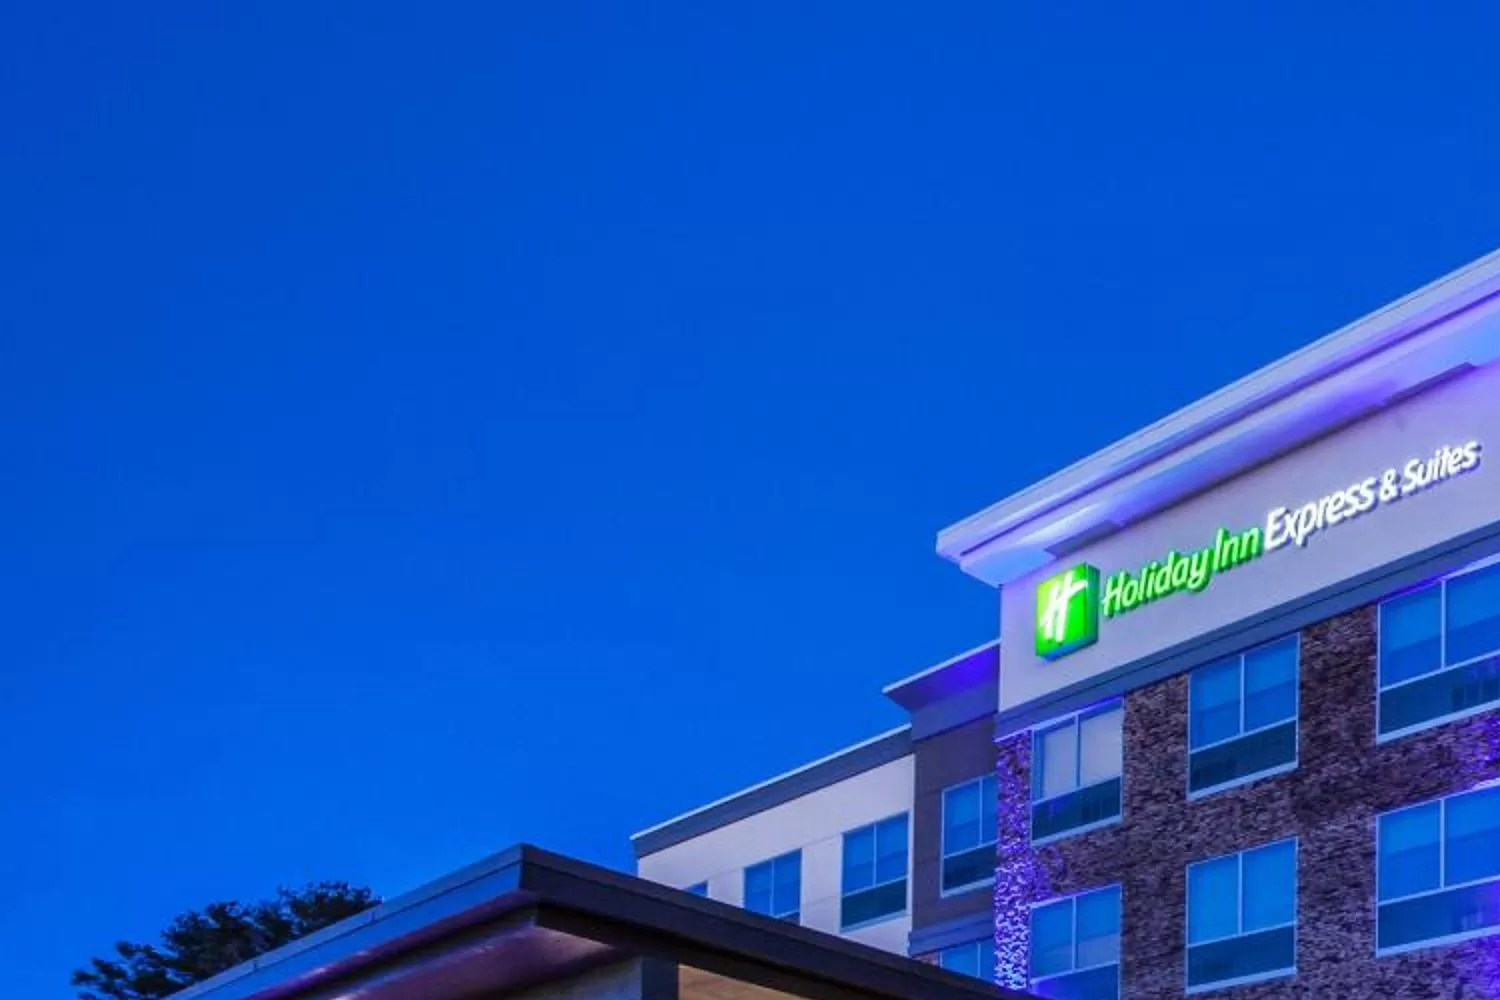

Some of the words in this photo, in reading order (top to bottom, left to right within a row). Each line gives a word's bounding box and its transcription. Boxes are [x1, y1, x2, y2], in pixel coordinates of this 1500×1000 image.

[1102, 551, 1211, 617] Holiday
[1213, 527, 1264, 572] Inn
[1264, 476, 1378, 549] Express
[1379, 467, 1400, 502] &
[1401, 440, 1481, 494] Suites
